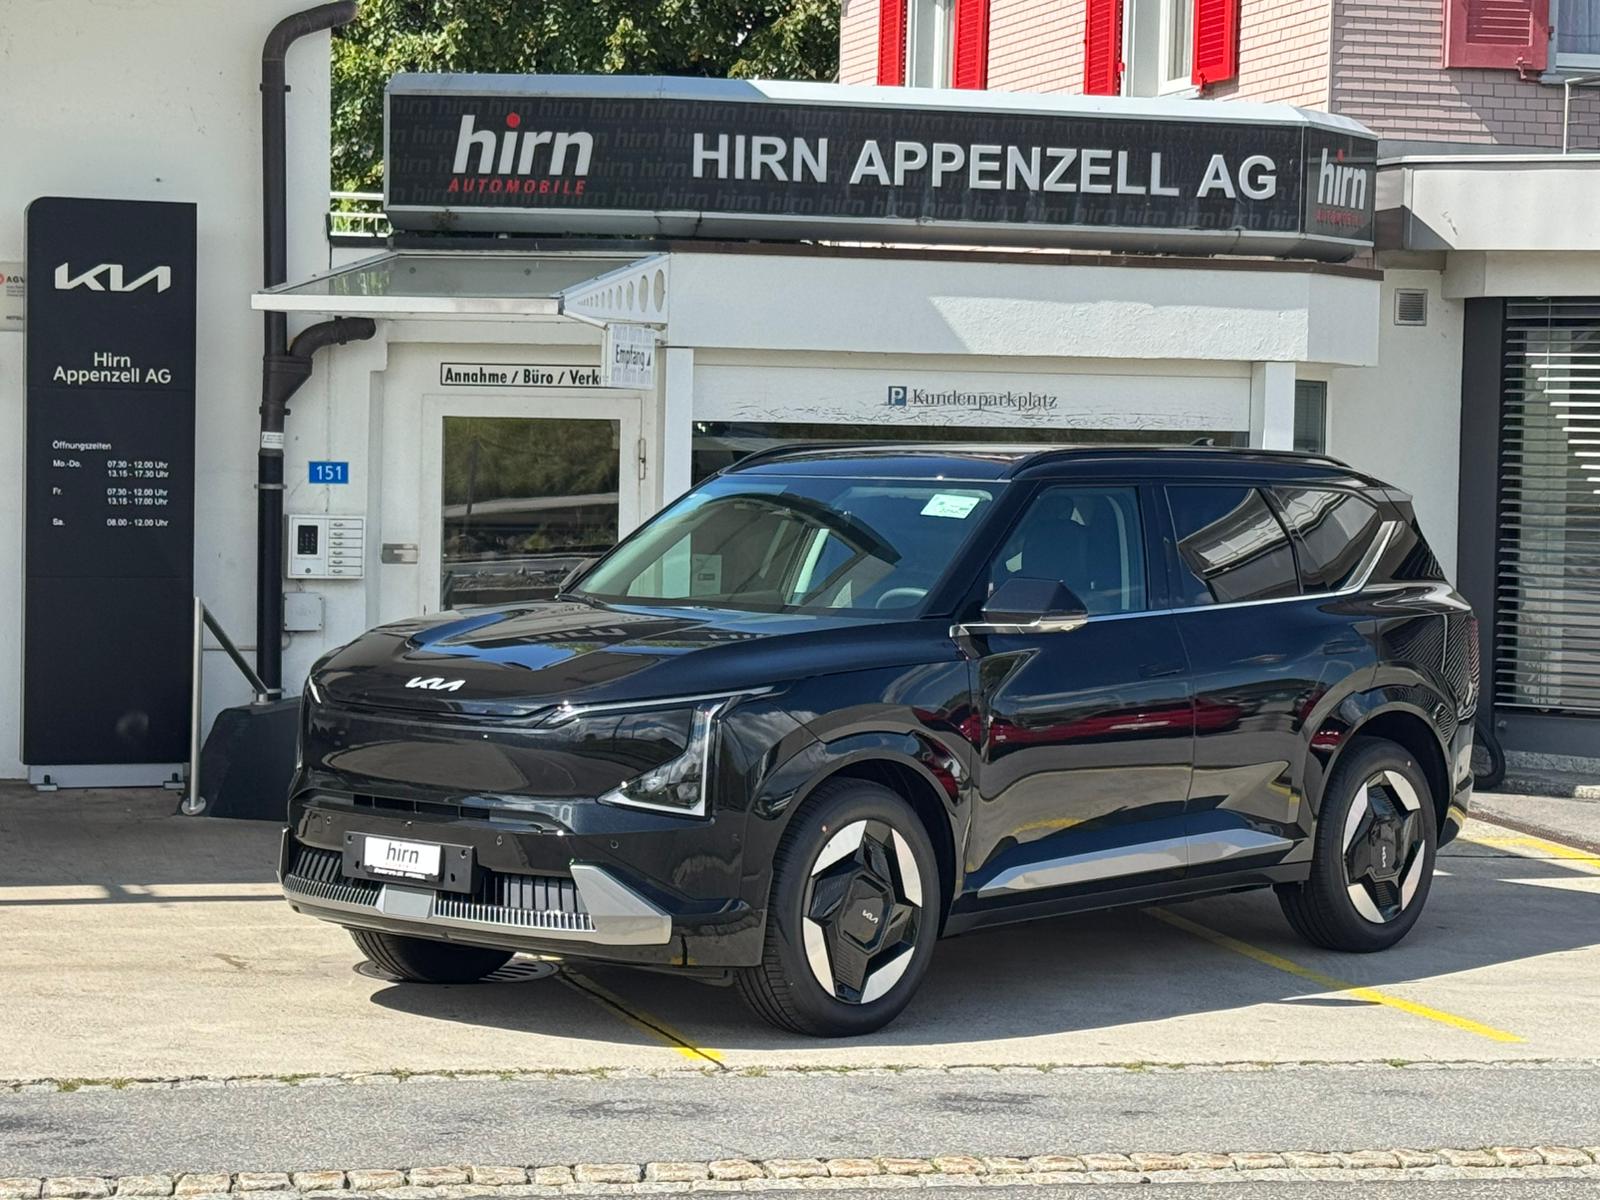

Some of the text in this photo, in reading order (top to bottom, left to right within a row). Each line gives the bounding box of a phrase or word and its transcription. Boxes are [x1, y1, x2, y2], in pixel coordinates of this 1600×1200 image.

[452, 112, 594, 176] hirn
[692, 132, 1277, 201] HIRN APPENZELL AG
[448, 178, 586, 195] AUTOMOBILE
[1317, 147, 1367, 210] hirn
[54, 262, 171, 293] KIA
[93, 352, 131, 368] Hirn
[616, 344, 645, 371] Empfang
[53, 366, 172, 385] Appenzell AG
[444, 367, 508, 384] Annahme
[523, 369, 554, 385] Büro
[913, 388, 1058, 411] Kundenparkplatz
[52, 440, 112, 452] Öffnungszeiten
[107, 460, 128, 469] 07.30
[134, 460, 154, 469] 12.00
[155, 461, 168, 469] Uhr
[316, 466, 343, 480] 151
[108, 470, 128, 478] 13.15
[134, 470, 154, 478] 17.30
[155, 470, 169, 478] Uhr
[52, 487, 63, 495] Fr.
[107, 488, 127, 496] 07.30
[134, 488, 154, 496] 12.00
[154, 488, 168, 496] Uhr
[108, 497, 128, 505] 13.15
[134, 498, 153, 506] 17.00
[154, 498, 168, 506] Uhr
[52, 518, 65, 526] Sa.
[106, 518, 128, 526] 08.00
[134, 519, 154, 527] 12.00
[155, 519, 168, 527] Uhr
[405, 676, 466, 691] KIA
[386, 841, 419, 864] hirn
